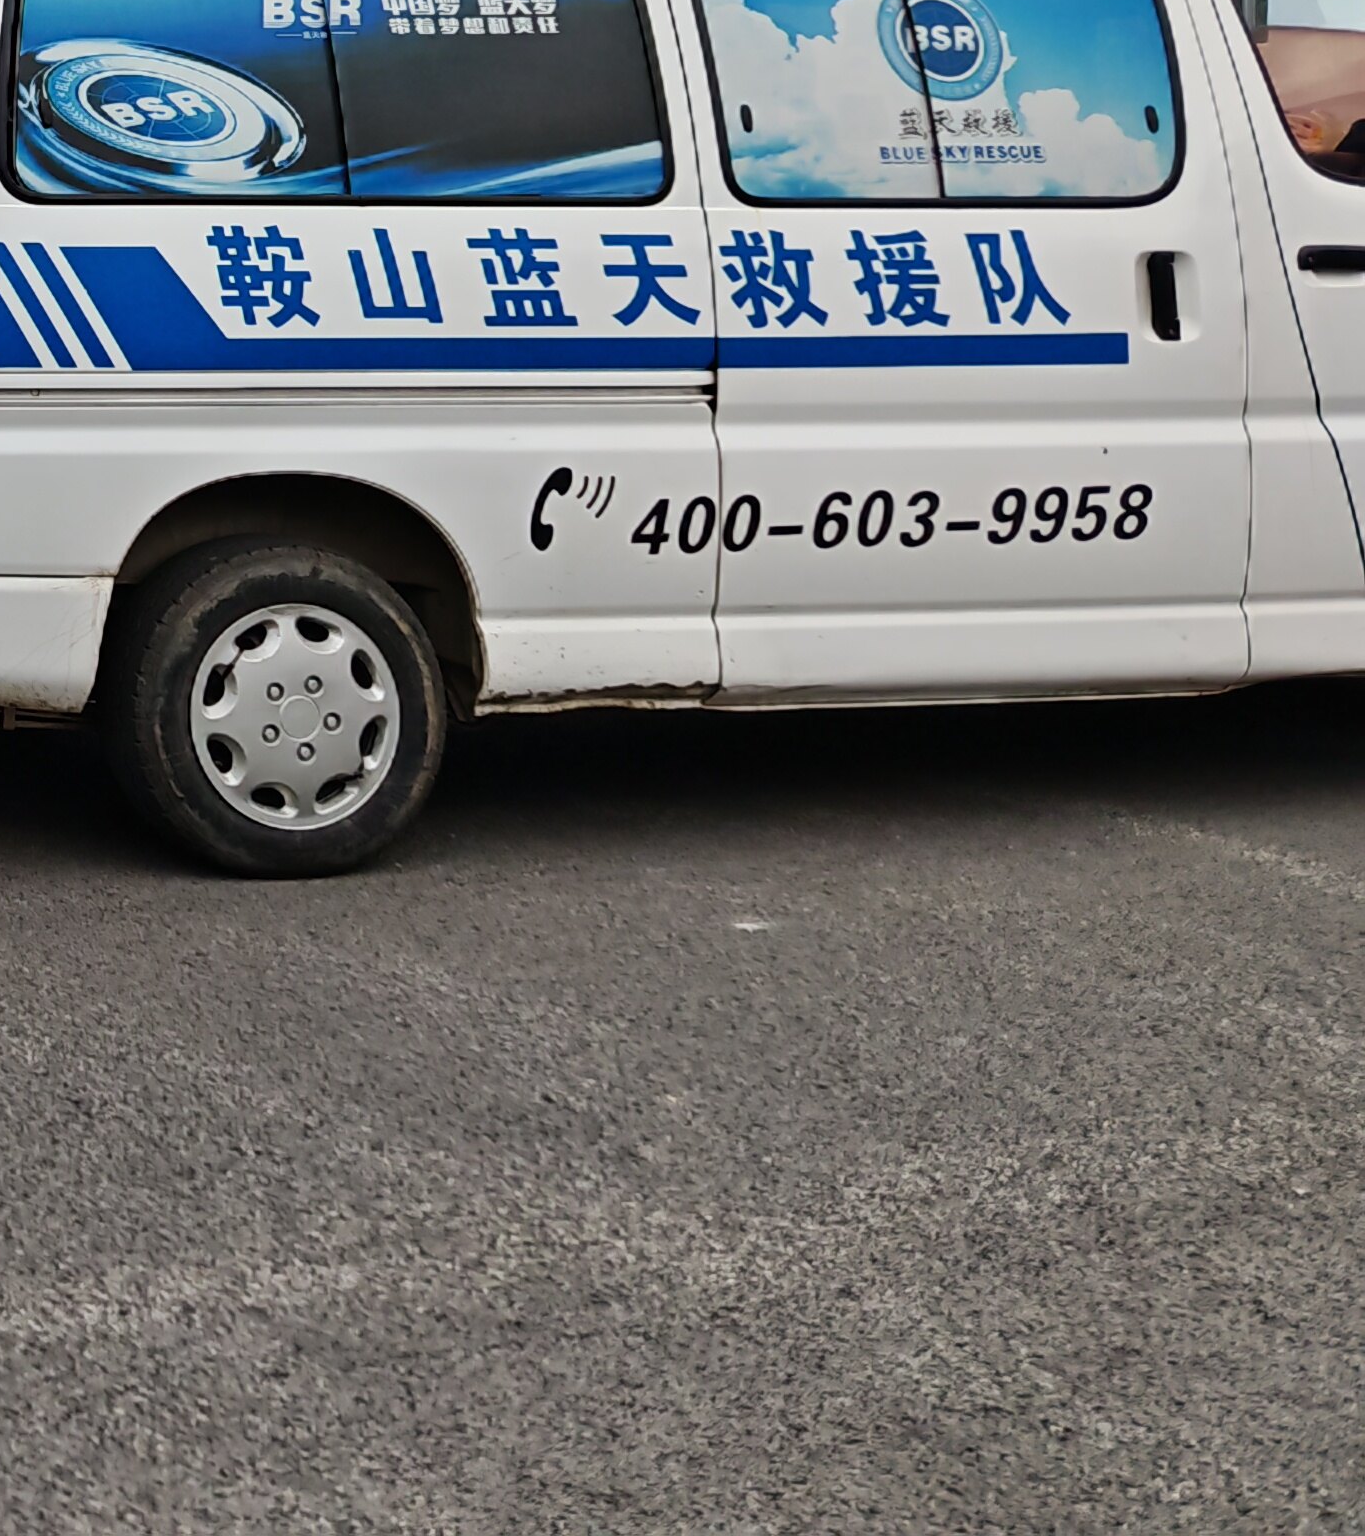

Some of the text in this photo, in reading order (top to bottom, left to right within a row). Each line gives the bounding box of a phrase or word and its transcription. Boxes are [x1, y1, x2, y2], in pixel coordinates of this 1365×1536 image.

[388, 16, 561, 35] 带着梦想和责任
[904, 25, 976, 54] BSR
[101, 89, 215, 129] BSR
[879, 144, 1045, 162] BLUE KY RESCUE
[207, 225, 1072, 330] 鞍山蓝天救援队
[630, 481, 1154, 557] 400-603-9958
